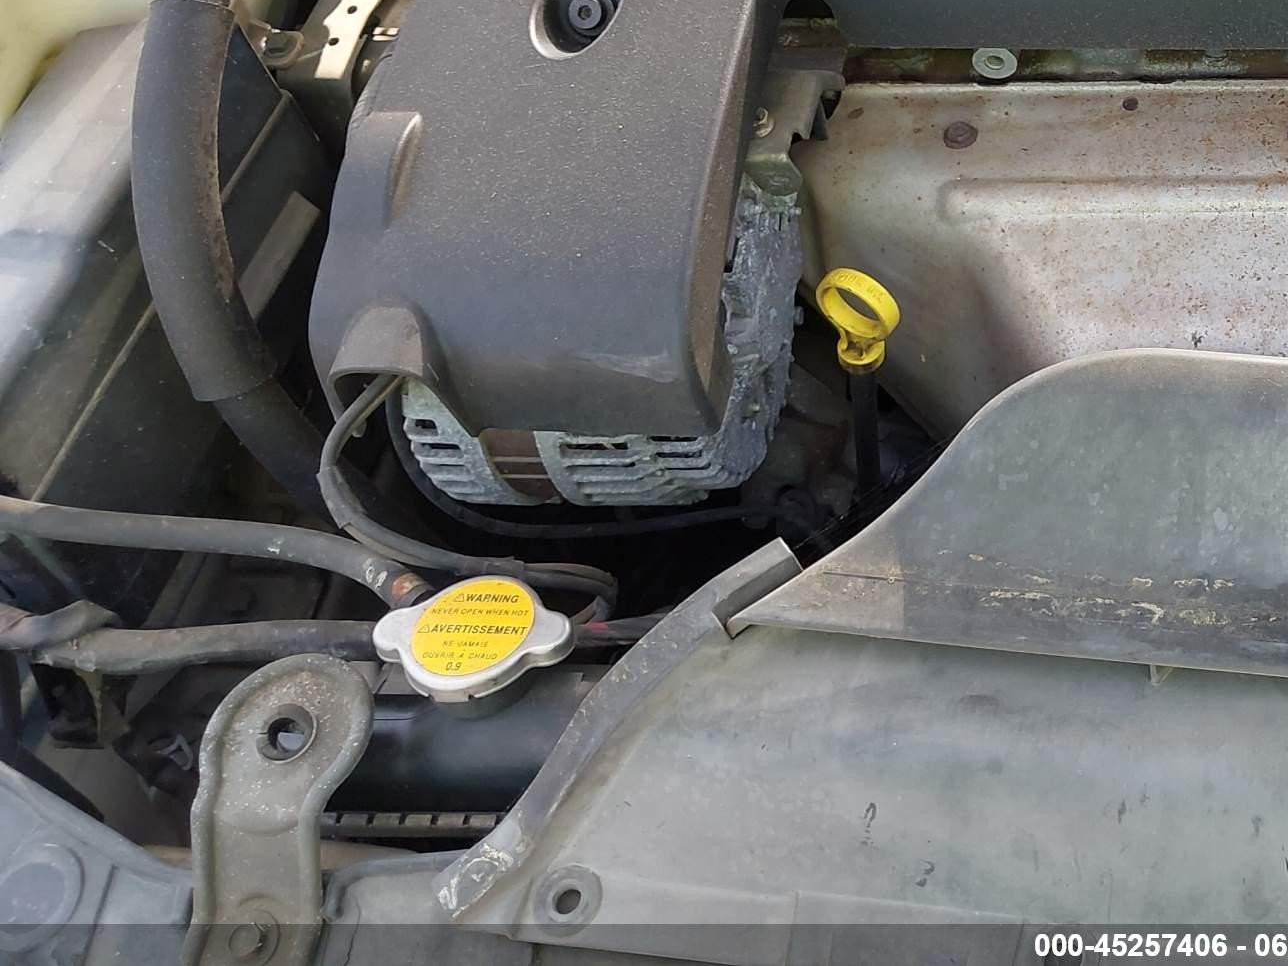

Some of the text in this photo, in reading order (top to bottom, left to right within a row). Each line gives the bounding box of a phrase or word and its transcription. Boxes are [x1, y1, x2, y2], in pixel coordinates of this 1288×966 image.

[466, 594, 519, 603] WARNING
[431, 624, 528, 635] AVERTISSEMENT
[445, 662, 462, 671] 0.9
